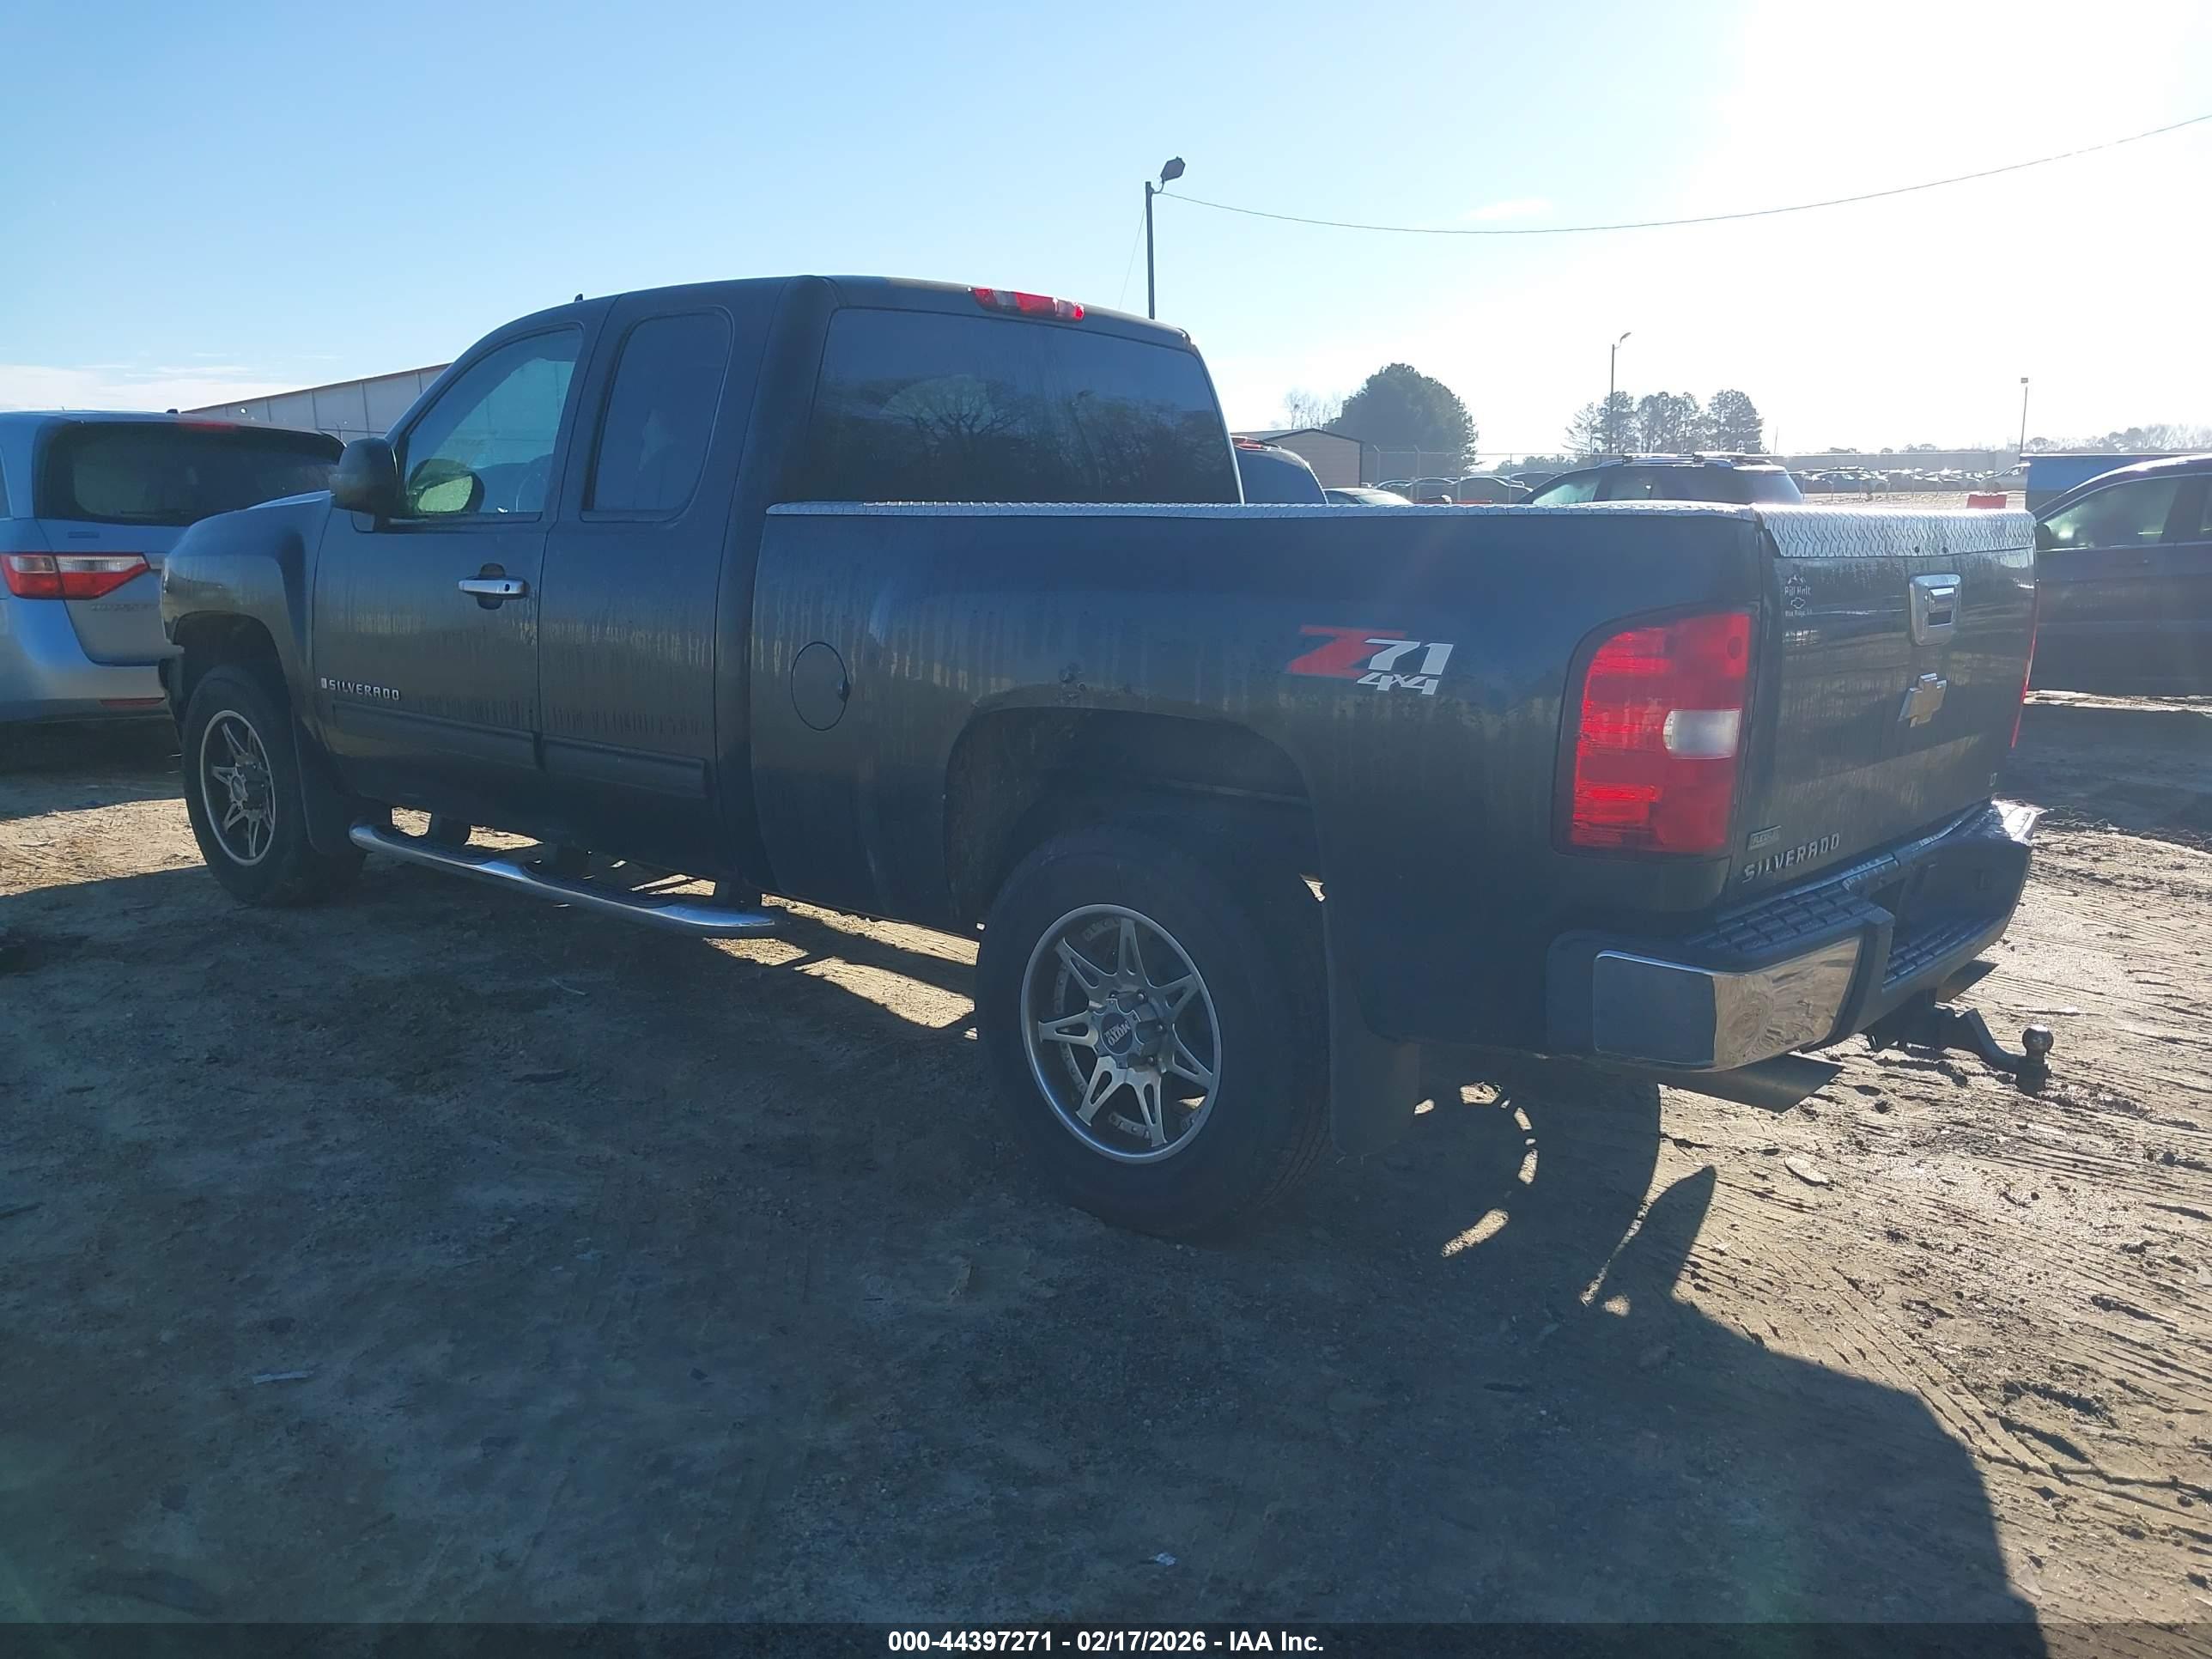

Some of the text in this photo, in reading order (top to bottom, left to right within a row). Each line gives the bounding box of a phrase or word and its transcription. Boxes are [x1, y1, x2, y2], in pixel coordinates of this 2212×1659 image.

[1285, 624, 1455, 679] Z71
[329, 679, 400, 701] SILVERADO
[1742, 831, 1841, 884] SILVERADO
